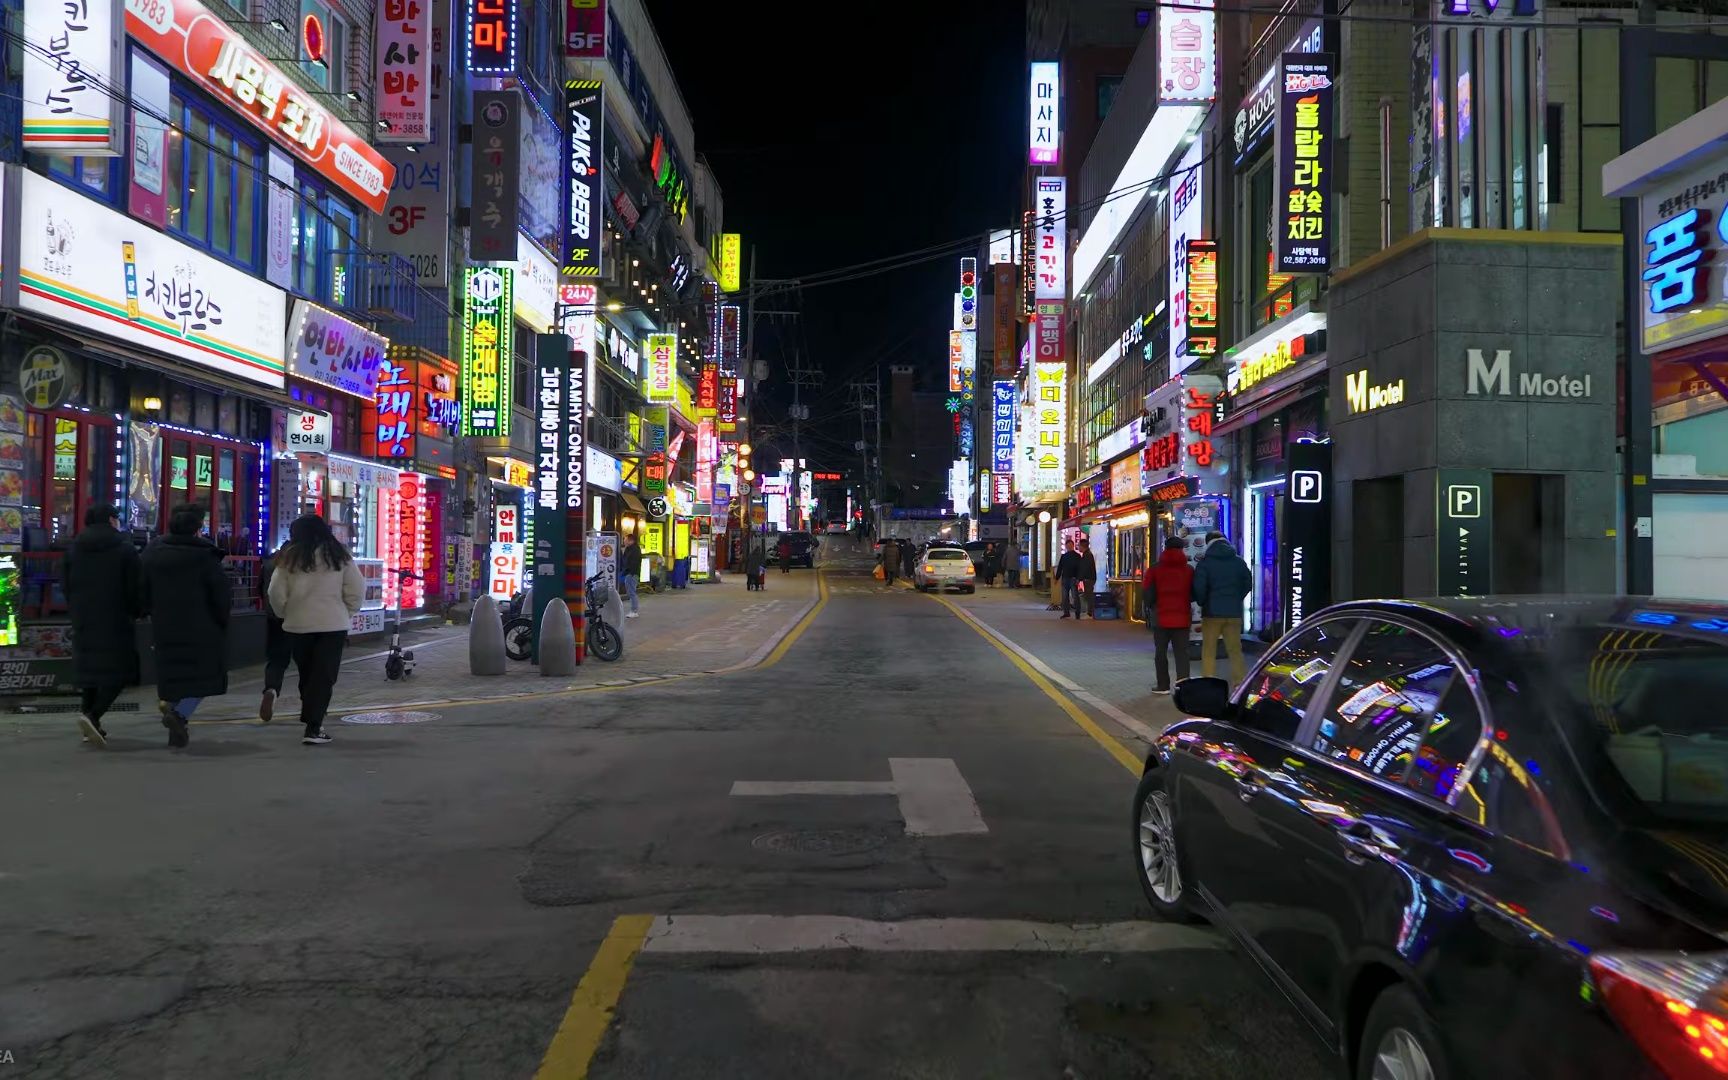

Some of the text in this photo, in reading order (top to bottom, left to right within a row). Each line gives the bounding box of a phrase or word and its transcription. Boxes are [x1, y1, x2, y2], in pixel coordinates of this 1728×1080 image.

[569, 32, 602, 49] 5F
[209, 39, 324, 151] 사당역 포차
[1037, 82, 1053, 143] 마사지
[338, 150, 380, 193] SINCE 1983
[388, 205, 426, 236] 3F
[571, 180, 590, 241] BEER
[1288, 188, 1323, 213] 참숯
[1287, 214, 1323, 240] 치킨
[572, 248, 589, 262] 2F
[145, 270, 223, 335] 치킨부르스
[566, 288, 590, 300] 24시
[304, 321, 381, 386] 연반사반
[653, 346, 671, 389] 삼겹살
[1466, 348, 1592, 398] M Motel
[24, 366, 58, 389] Max
[1345, 369, 1403, 414] M Motel
[301, 415, 315, 430] 생
[376, 359, 411, 456] 노래방
[1186, 387, 1215, 466] 노래방
[290, 432, 325, 445] 연어회
[539, 366, 561, 510] 남현동 먹자골목
[567, 367, 583, 508] NAMHYEON-DONG
[492, 555, 520, 599] 안마
[1292, 546, 1303, 581] VALET
[1459, 538, 1468, 576] VALET
